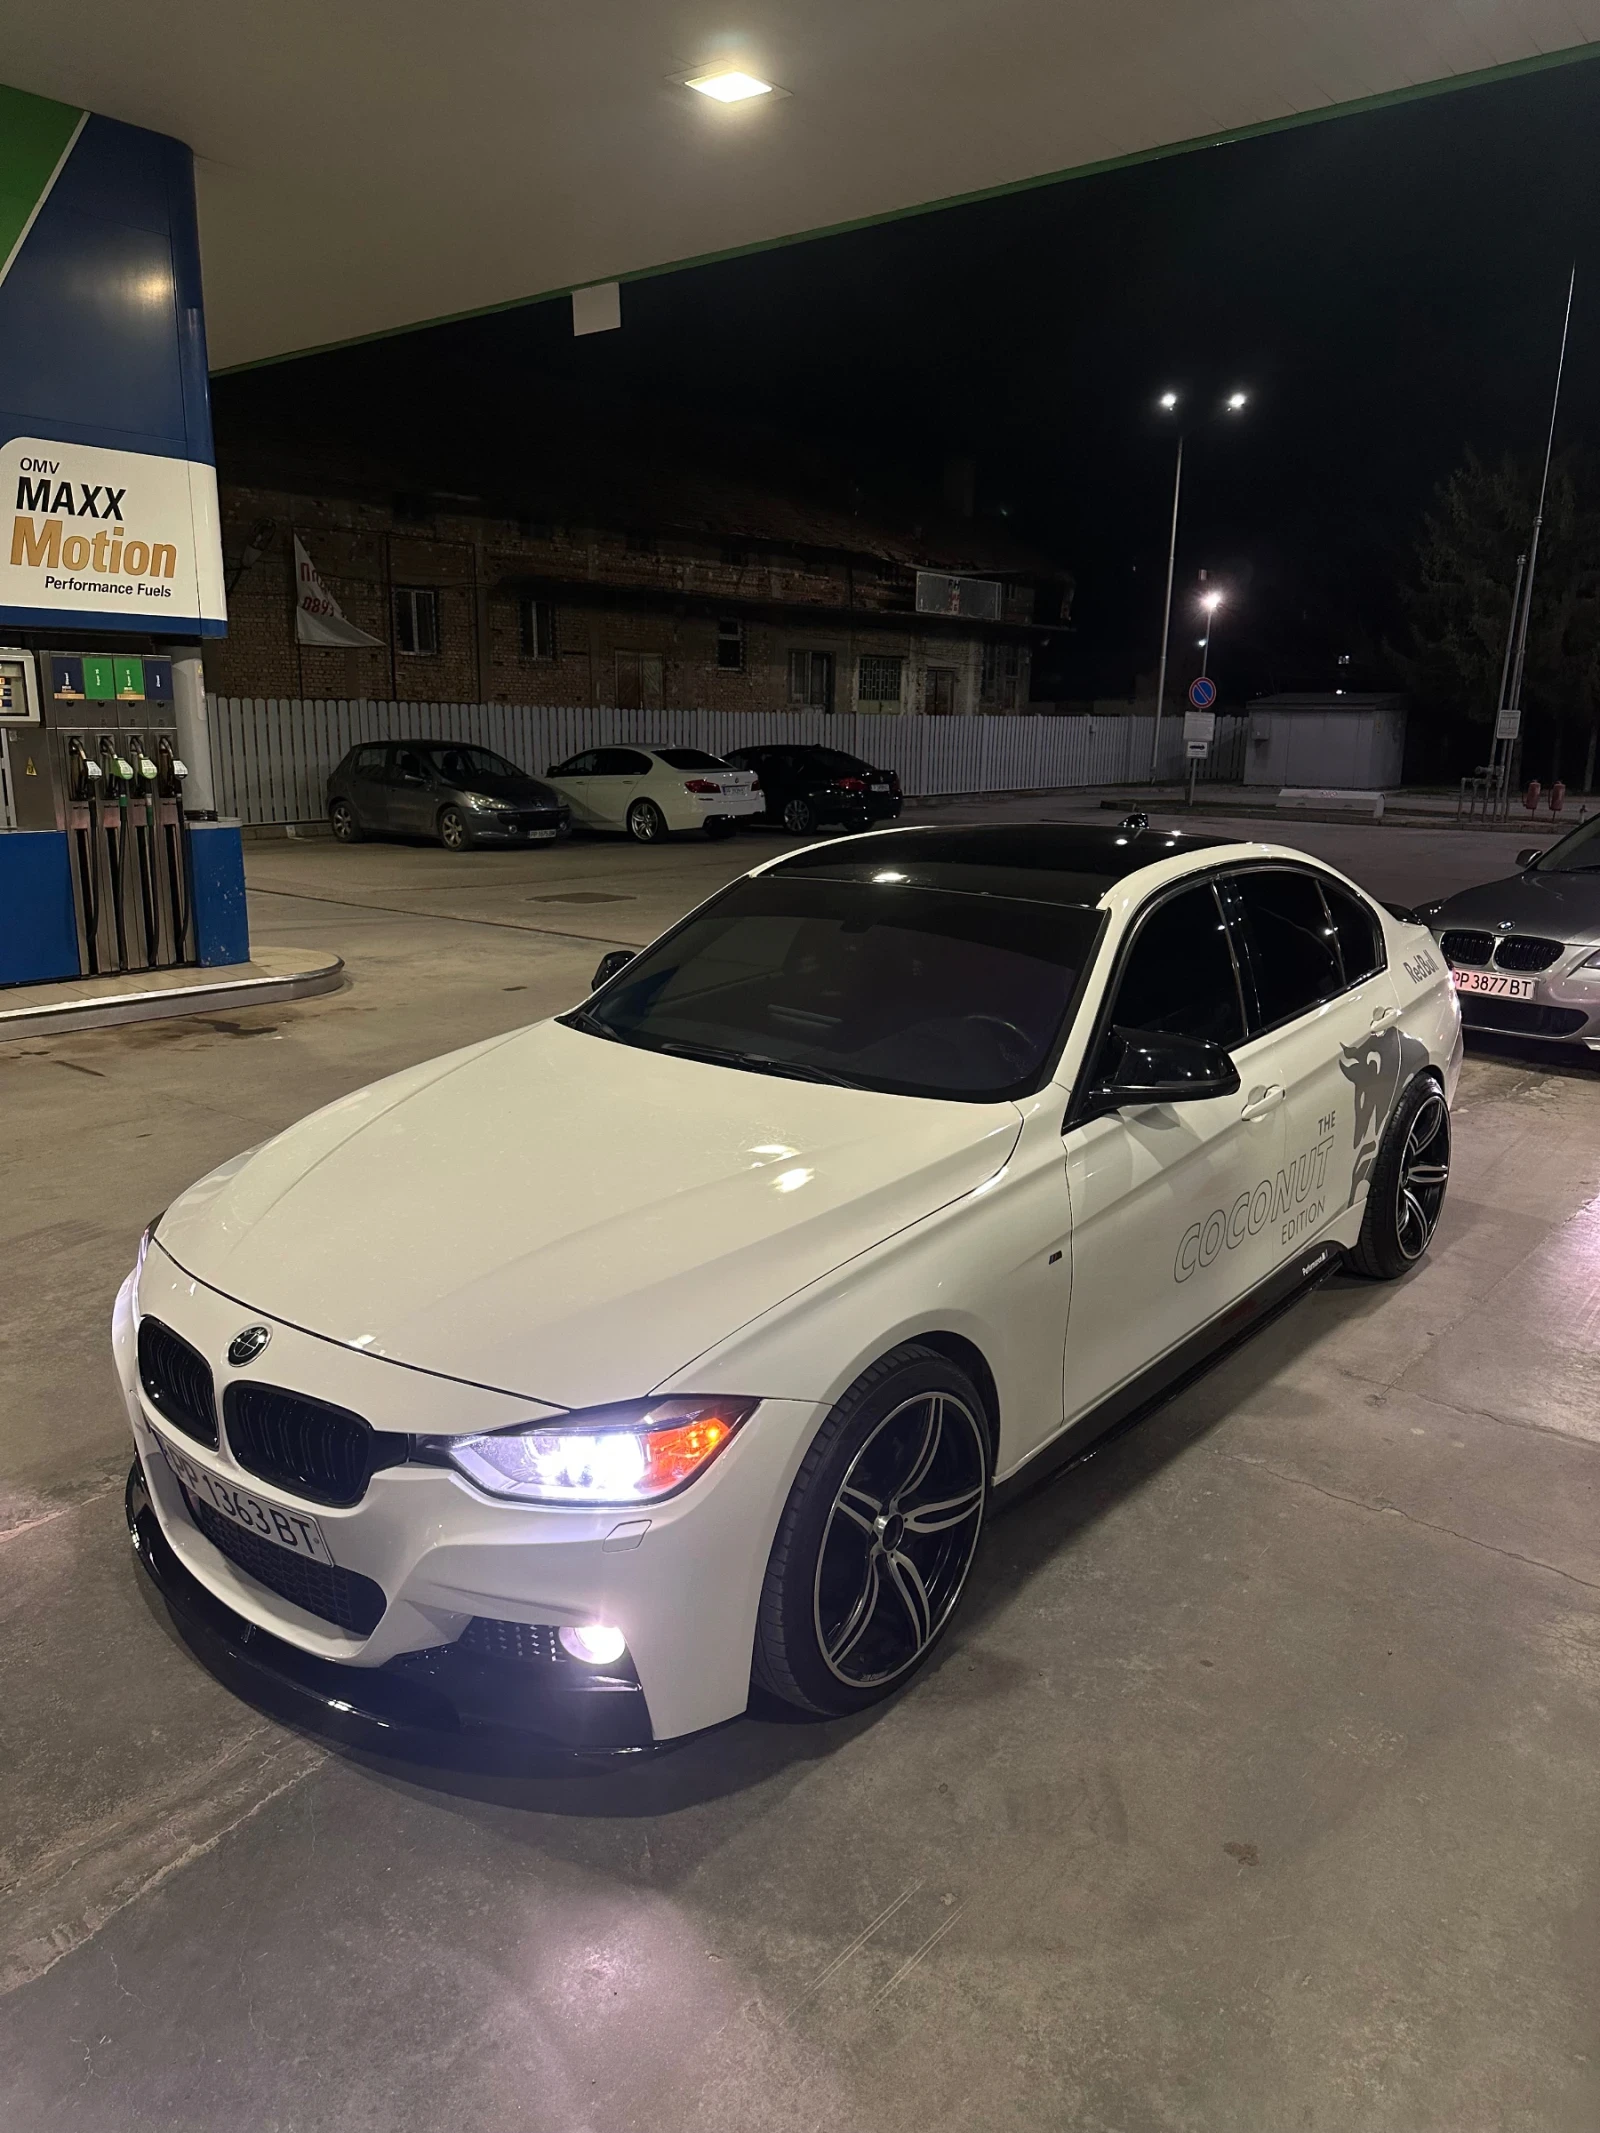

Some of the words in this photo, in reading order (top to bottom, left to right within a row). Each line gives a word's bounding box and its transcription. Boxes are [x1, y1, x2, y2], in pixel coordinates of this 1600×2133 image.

[19, 457, 60, 475] OMV
[16, 476, 126, 521] MAXX
[10, 515, 177, 578] Motion
[45, 575, 133, 595] Performance
[137, 583, 172, 598] Fuels
[1471, 975, 1508, 994] 3877
[1510, 979, 1532, 997] BT
[1317, 1110, 1336, 1137] THE
[1173, 1134, 1335, 1284] COCONUT
[1281, 1195, 1326, 1246] EDITION
[166, 1443, 199, 1490] PP
[202, 1474, 272, 1535] 1363
[268, 1508, 315, 1555] BT
